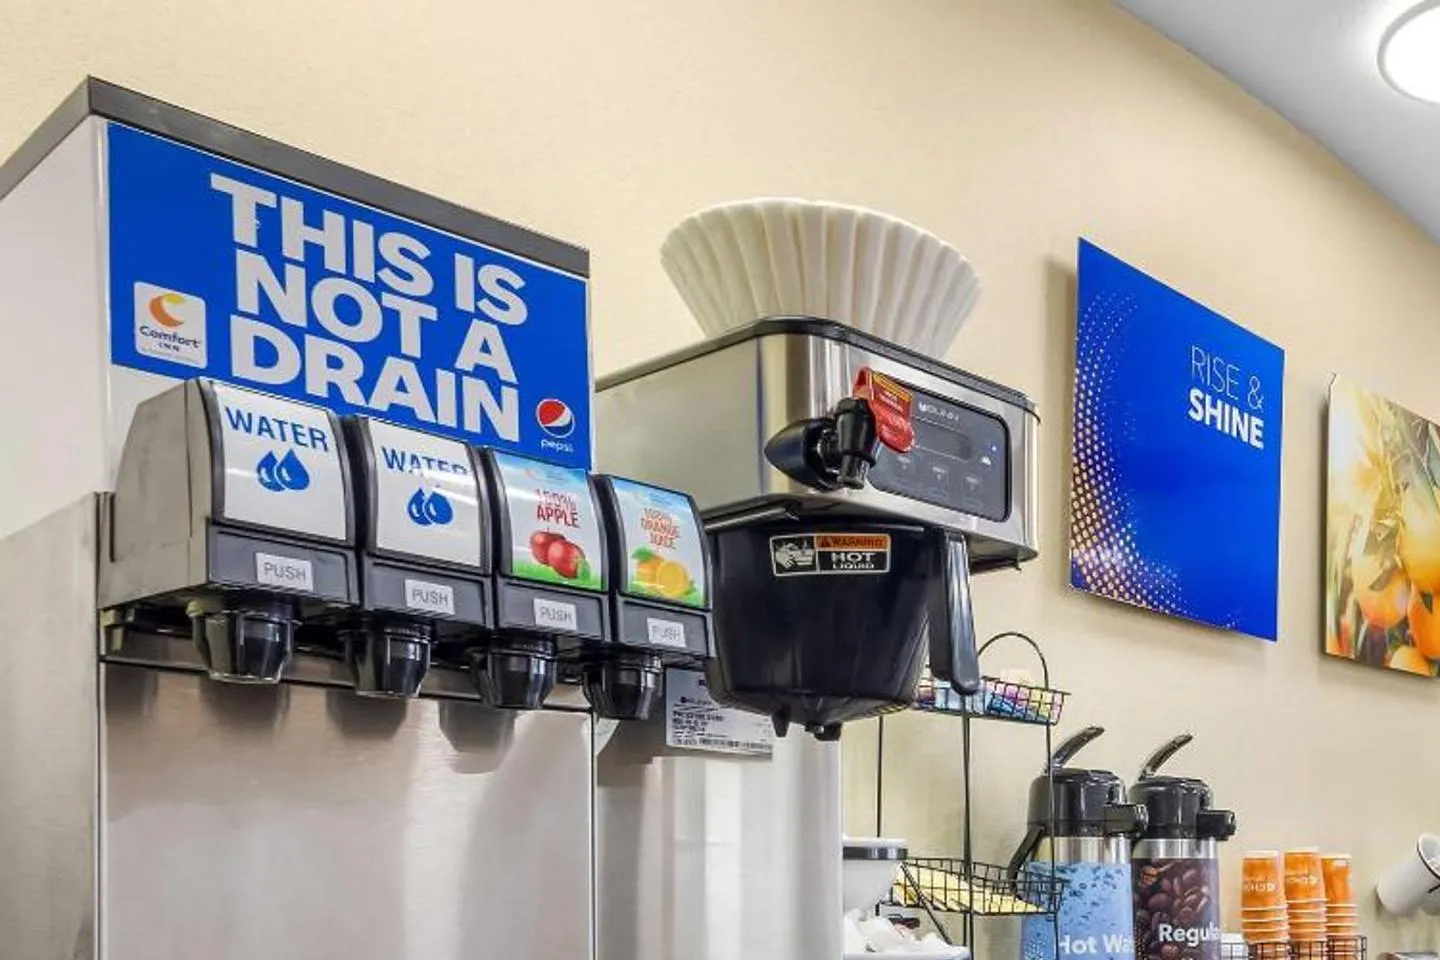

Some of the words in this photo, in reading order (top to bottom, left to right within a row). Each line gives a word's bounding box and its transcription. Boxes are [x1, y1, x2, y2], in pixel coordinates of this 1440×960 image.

[211, 172, 434, 297] THIS
[455, 253, 528, 326] IS
[236, 249, 437, 358] NOT
[455, 318, 517, 384] A
[139, 325, 200, 349] Comfort
[231, 314, 519, 442] DRAIN
[1190, 344, 1239, 400] RISE
[1247, 375, 1265, 410] &
[225, 406, 329, 452] WATER
[1188, 388, 1264, 449] SHINE
[540, 440, 574, 453] pepsi
[381, 445, 469, 475] WATER
[537, 503, 581, 529] APPLE
[832, 536, 886, 548] WARNING
[831, 552, 876, 563] HOT
[832, 562, 875, 570] LIQUID
[263, 561, 307, 583] PUSH
[412, 590, 449, 606] PUSH
[539, 606, 573, 622] PUSH
[651, 625, 682, 640] PUSH
